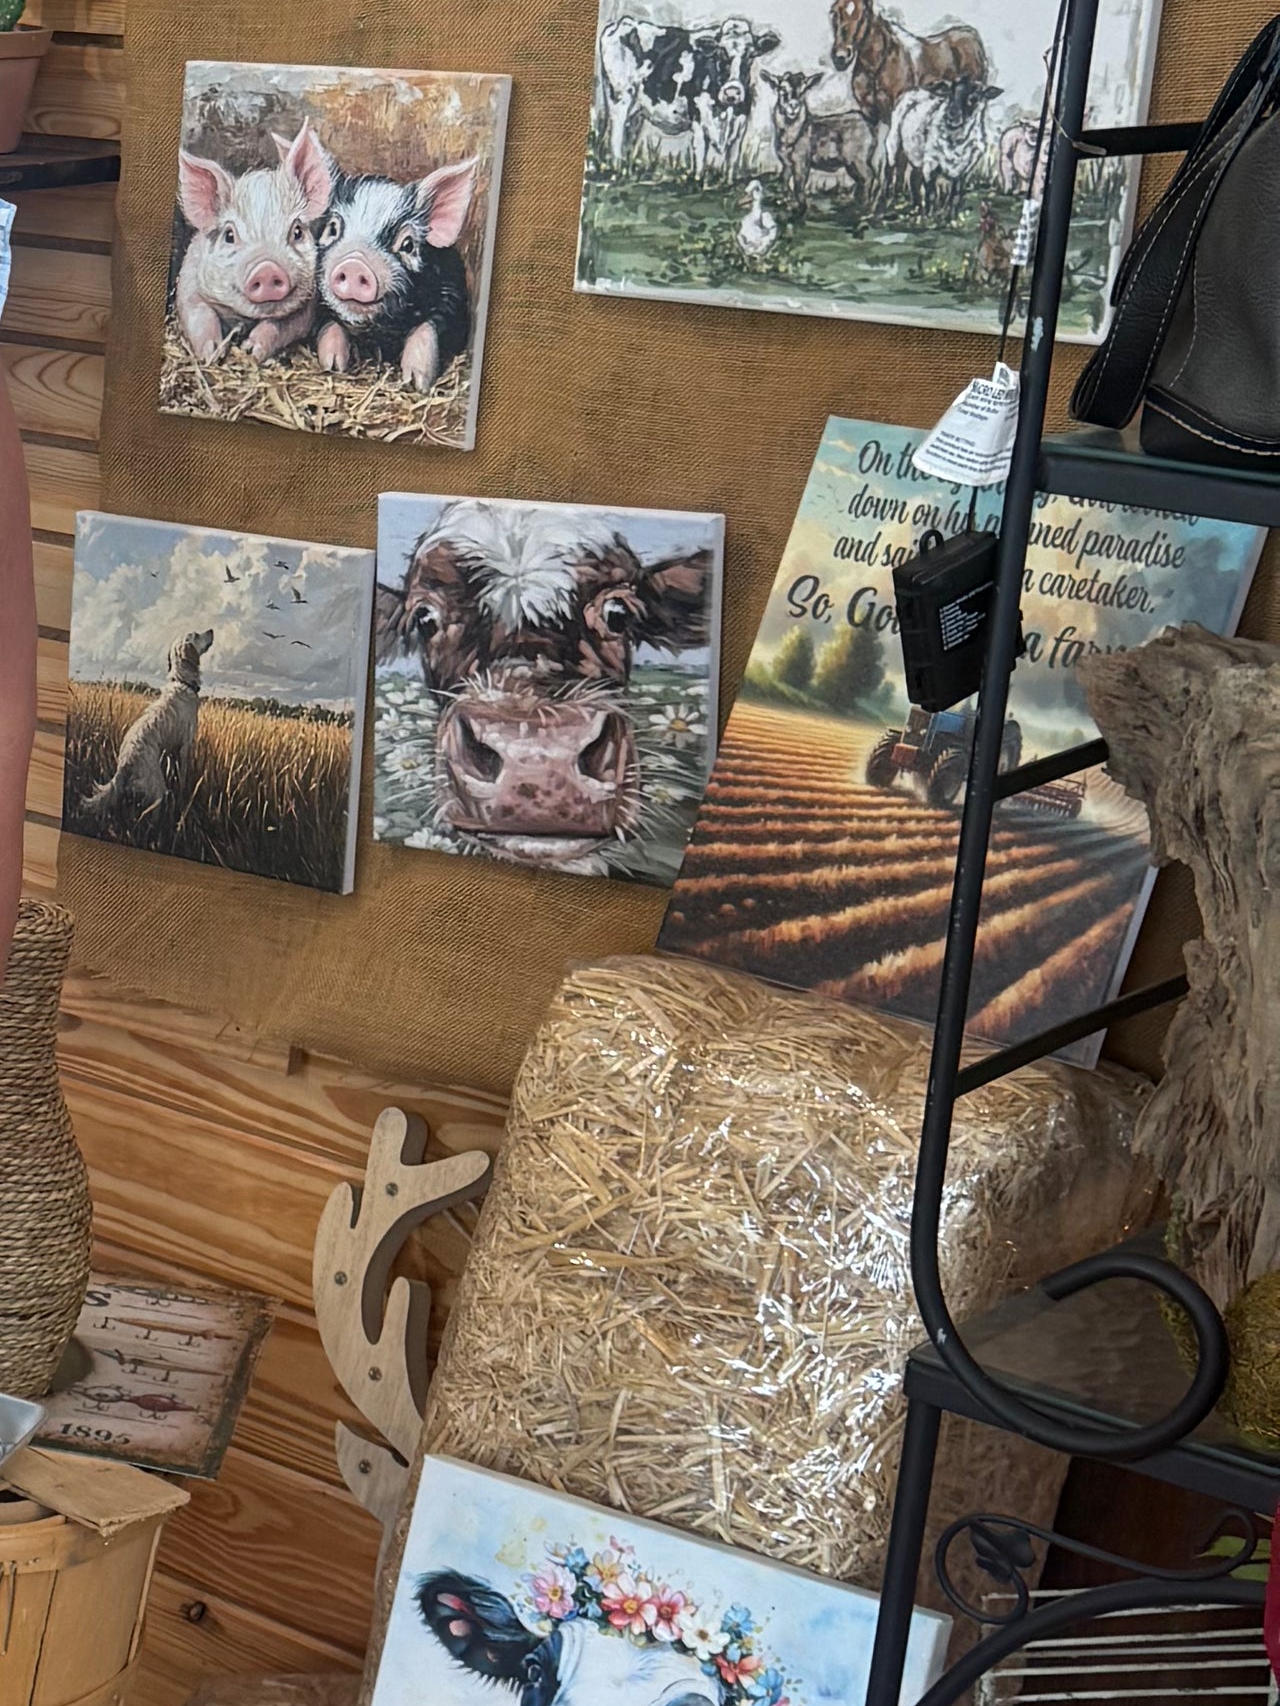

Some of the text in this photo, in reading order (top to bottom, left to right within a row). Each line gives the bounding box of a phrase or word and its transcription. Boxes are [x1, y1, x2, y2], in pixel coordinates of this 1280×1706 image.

[858, 440, 893, 476] On
[895, 441, 932, 482] th
[848, 483, 909, 524] down
[912, 503, 942, 529] on
[1075, 529, 1186, 570] paradise
[833, 531, 882, 567] and
[787, 575, 835, 624] So,
[59, 1422, 135, 1446] 1895
